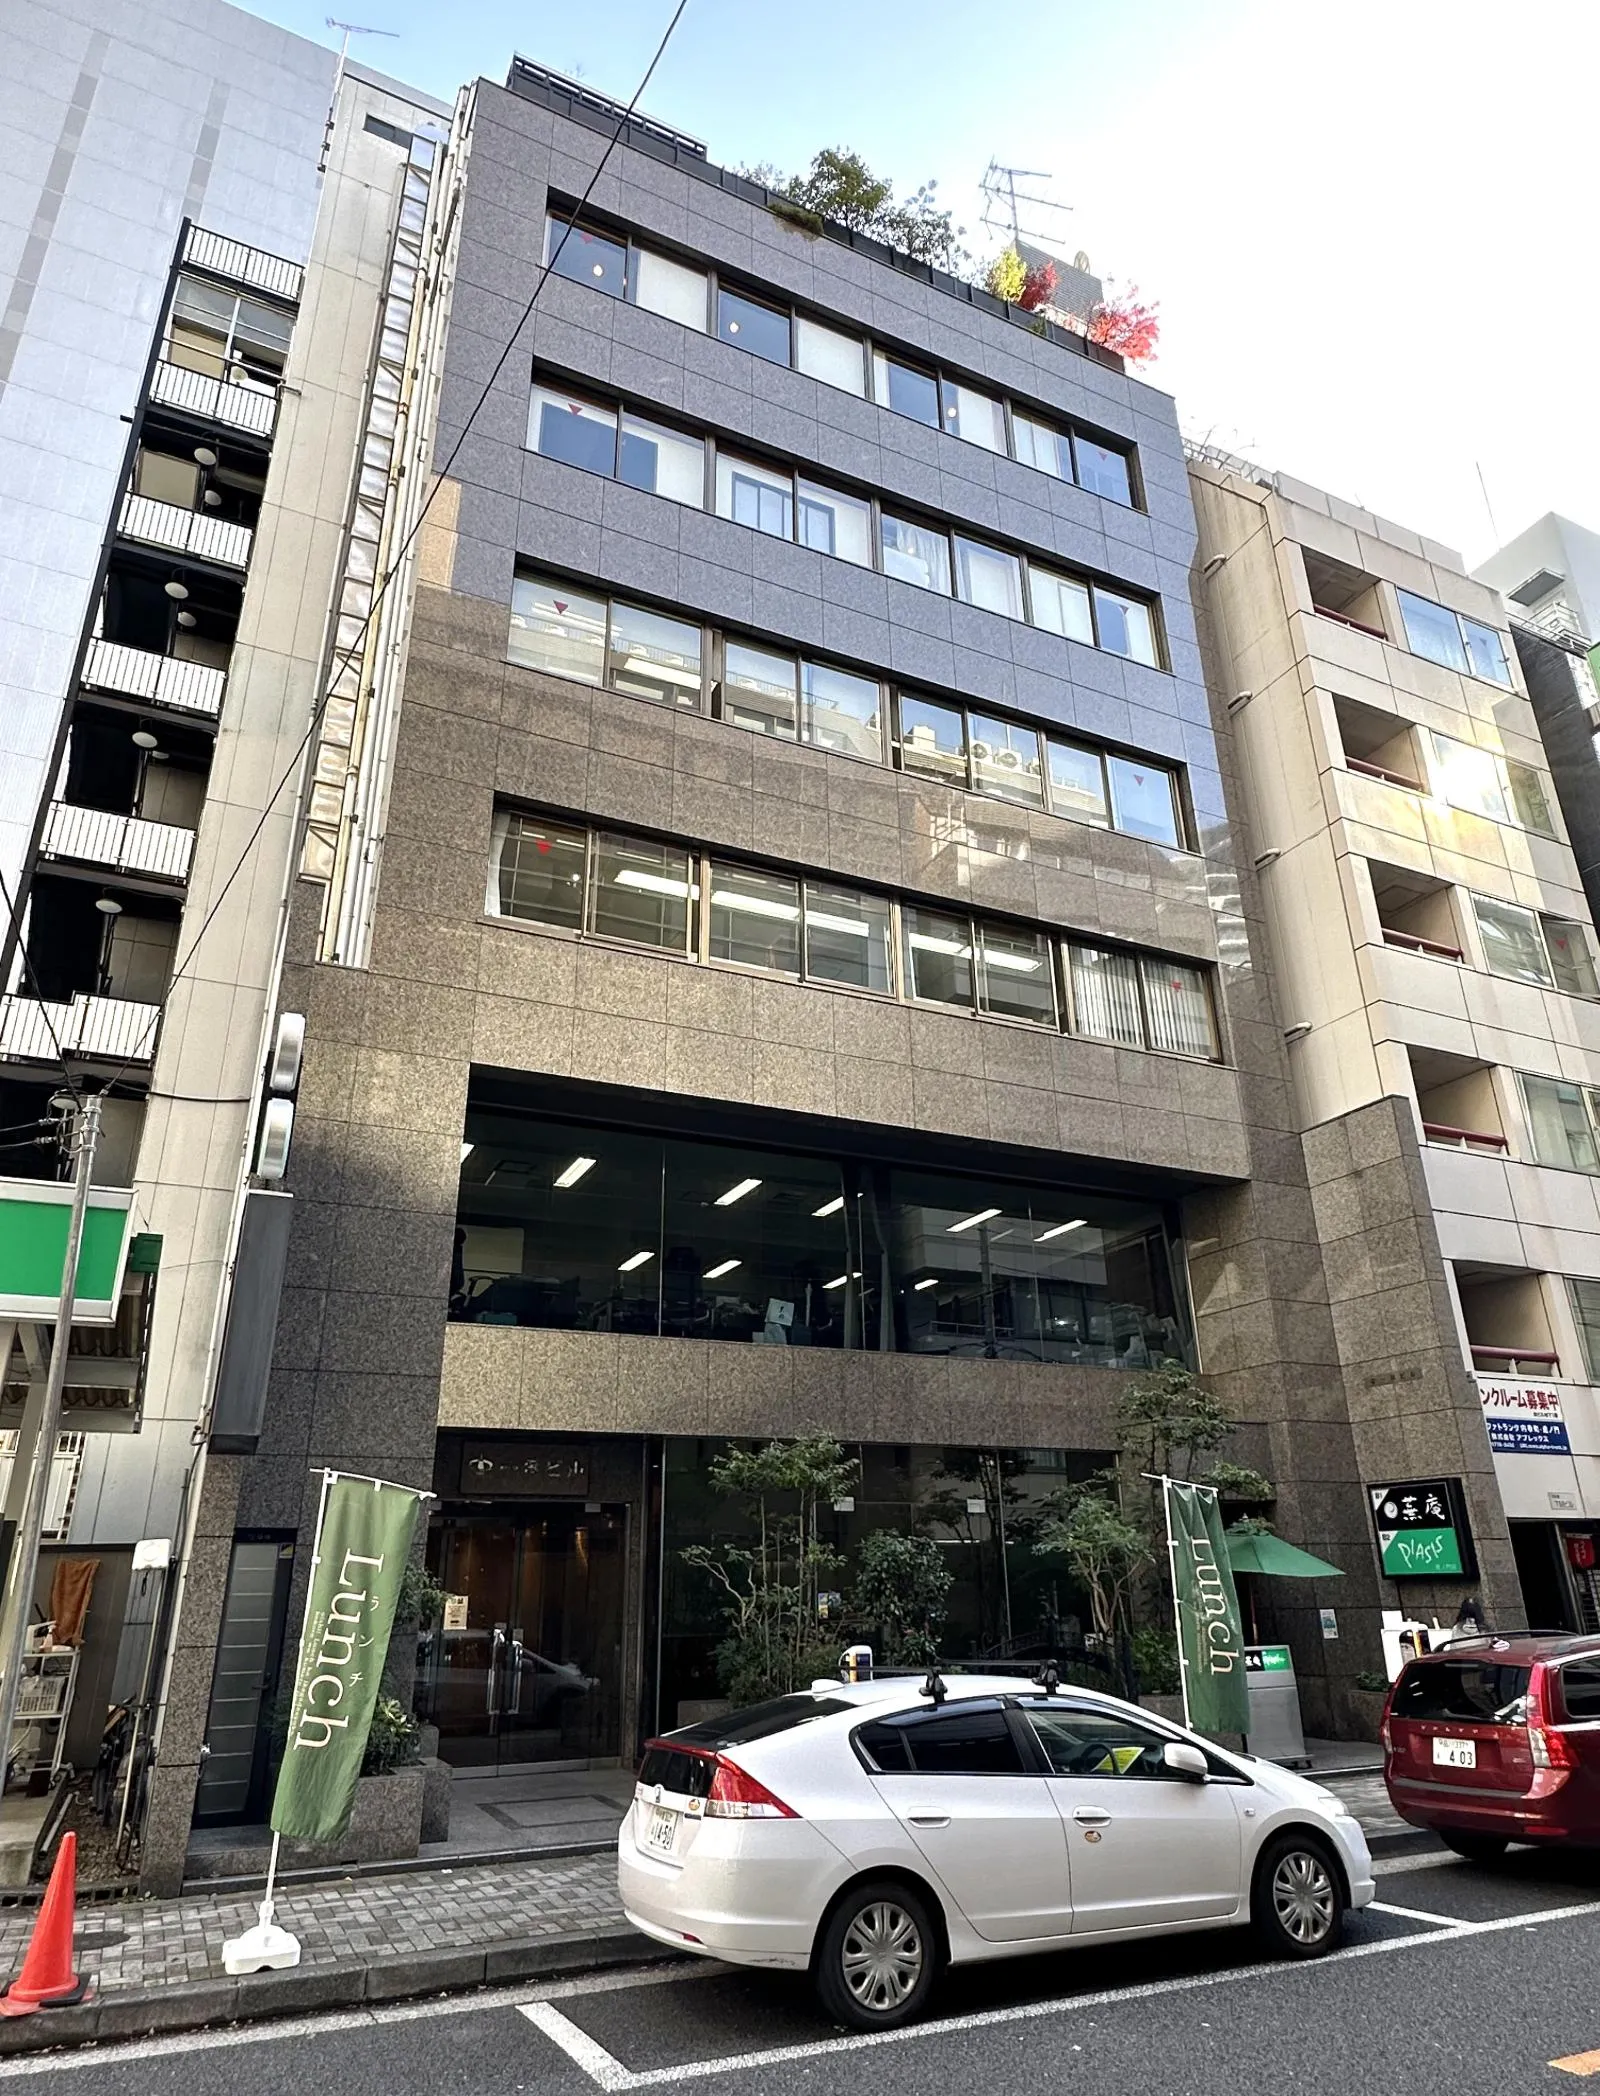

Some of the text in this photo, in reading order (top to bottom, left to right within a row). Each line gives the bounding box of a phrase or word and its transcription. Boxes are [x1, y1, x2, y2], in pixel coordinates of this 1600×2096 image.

[293, 1547, 385, 1751] Lunch
[349, 1595, 380, 1688] ランチ
[1190, 1535, 1240, 1676] Lunch
